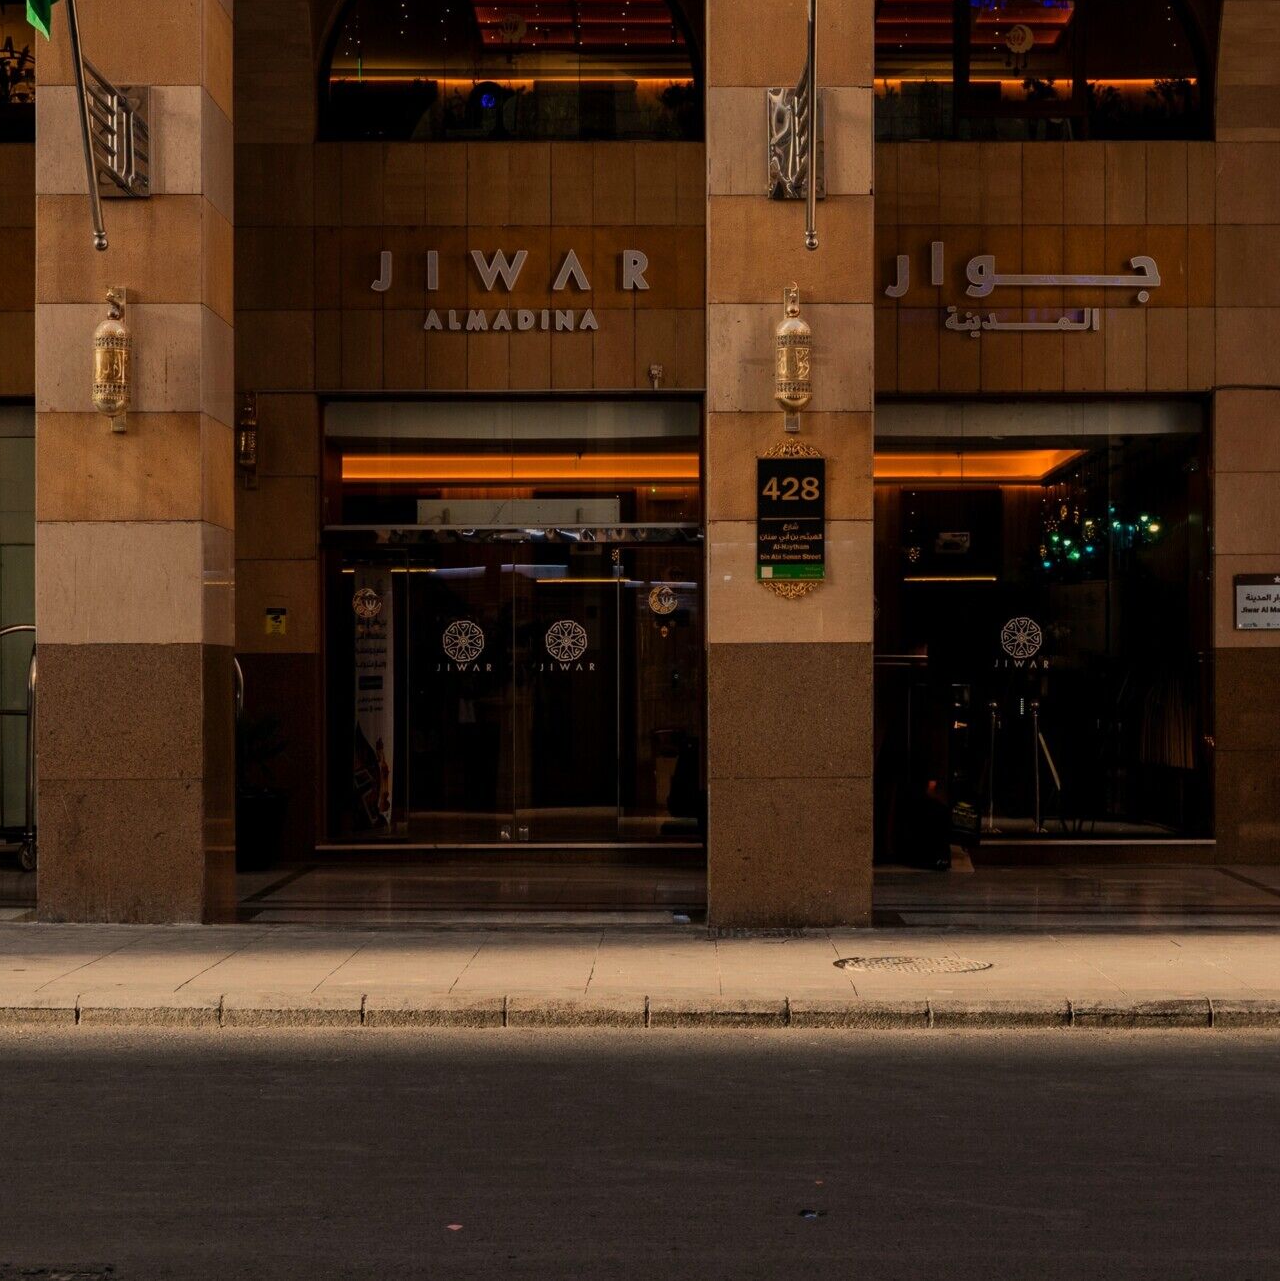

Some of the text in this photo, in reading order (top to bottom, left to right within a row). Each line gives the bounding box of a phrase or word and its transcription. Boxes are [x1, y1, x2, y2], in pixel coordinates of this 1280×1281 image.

[370, 248, 650, 291] JIWAR
[423, 308, 599, 331] ALMADINA
[945, 305, 1100, 338] المدينة
[762, 476, 820, 501] 428
[783, 522, 799, 531] شارع
[1245, 593, 1271, 603] المدينة
[540, 663, 595, 671] JIWAR
[994, 659, 1049, 669] JIWAR
